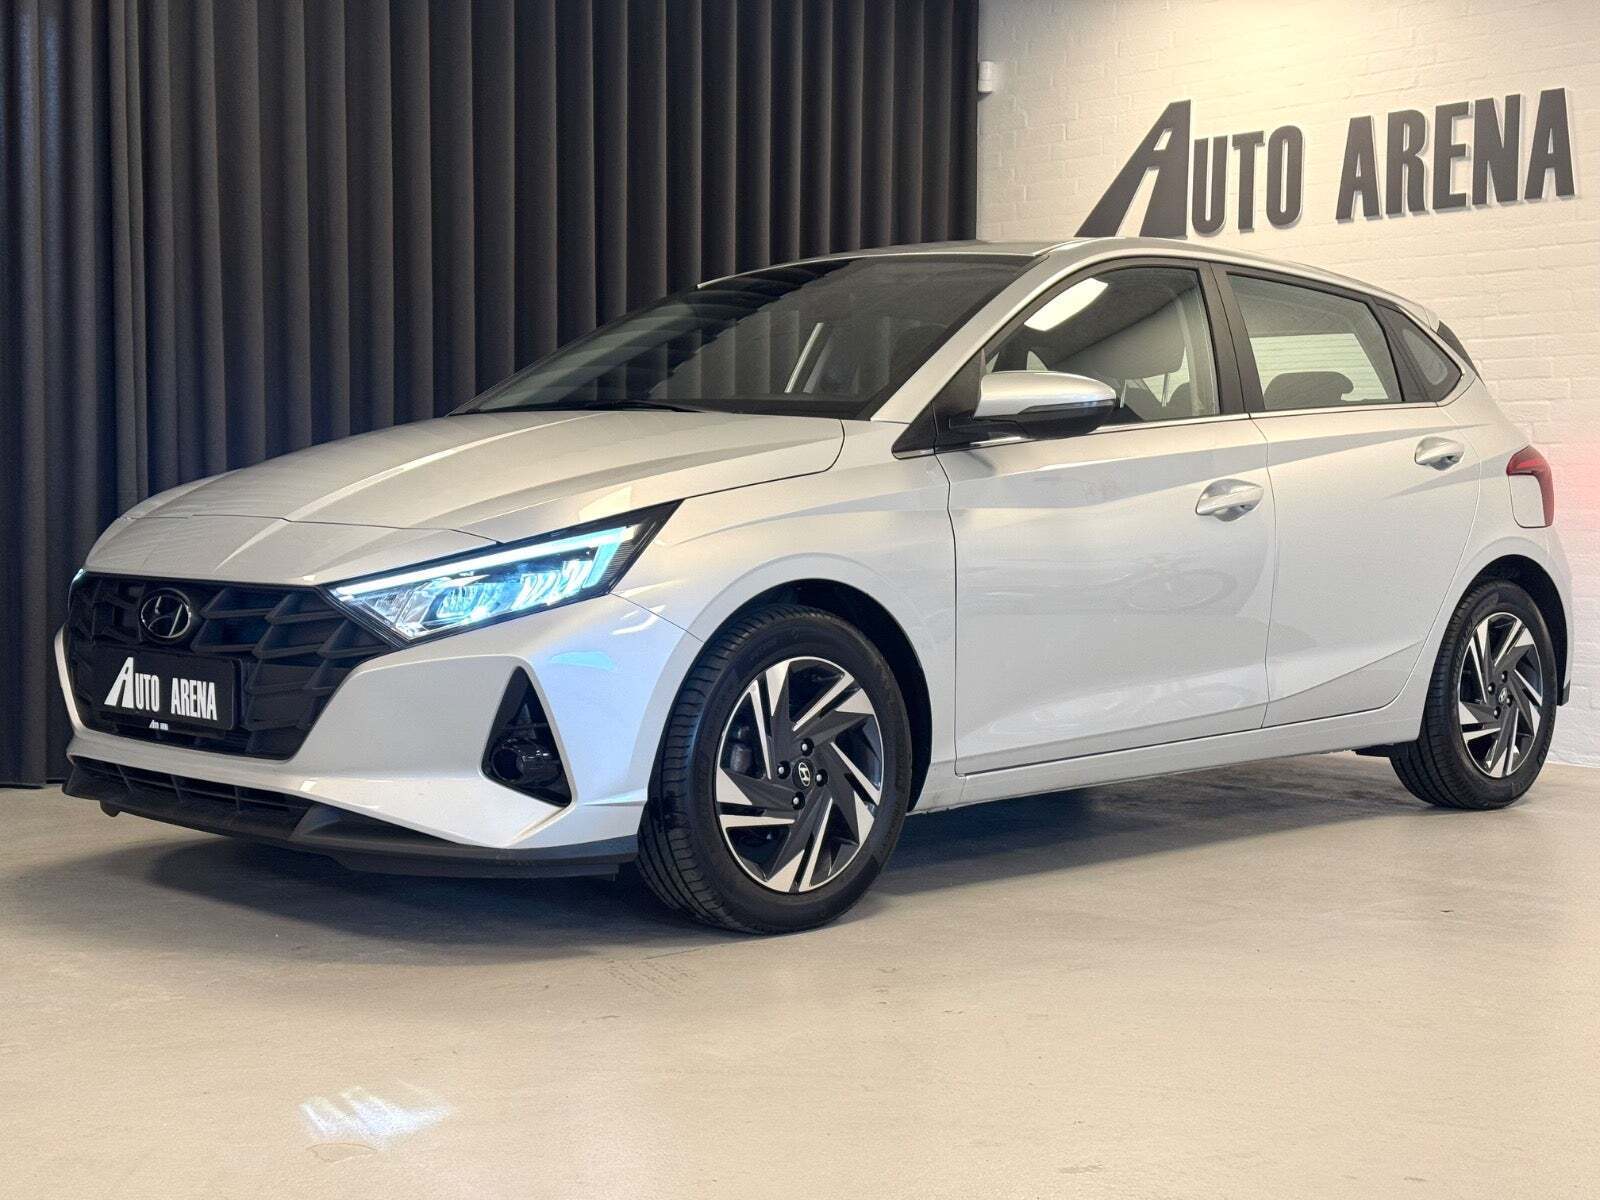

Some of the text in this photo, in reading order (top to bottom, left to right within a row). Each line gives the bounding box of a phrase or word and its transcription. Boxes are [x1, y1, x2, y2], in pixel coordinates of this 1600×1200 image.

[1074, 88, 1576, 239] AUTO ARENA
[104, 657, 218, 721] AUTO ARENA
